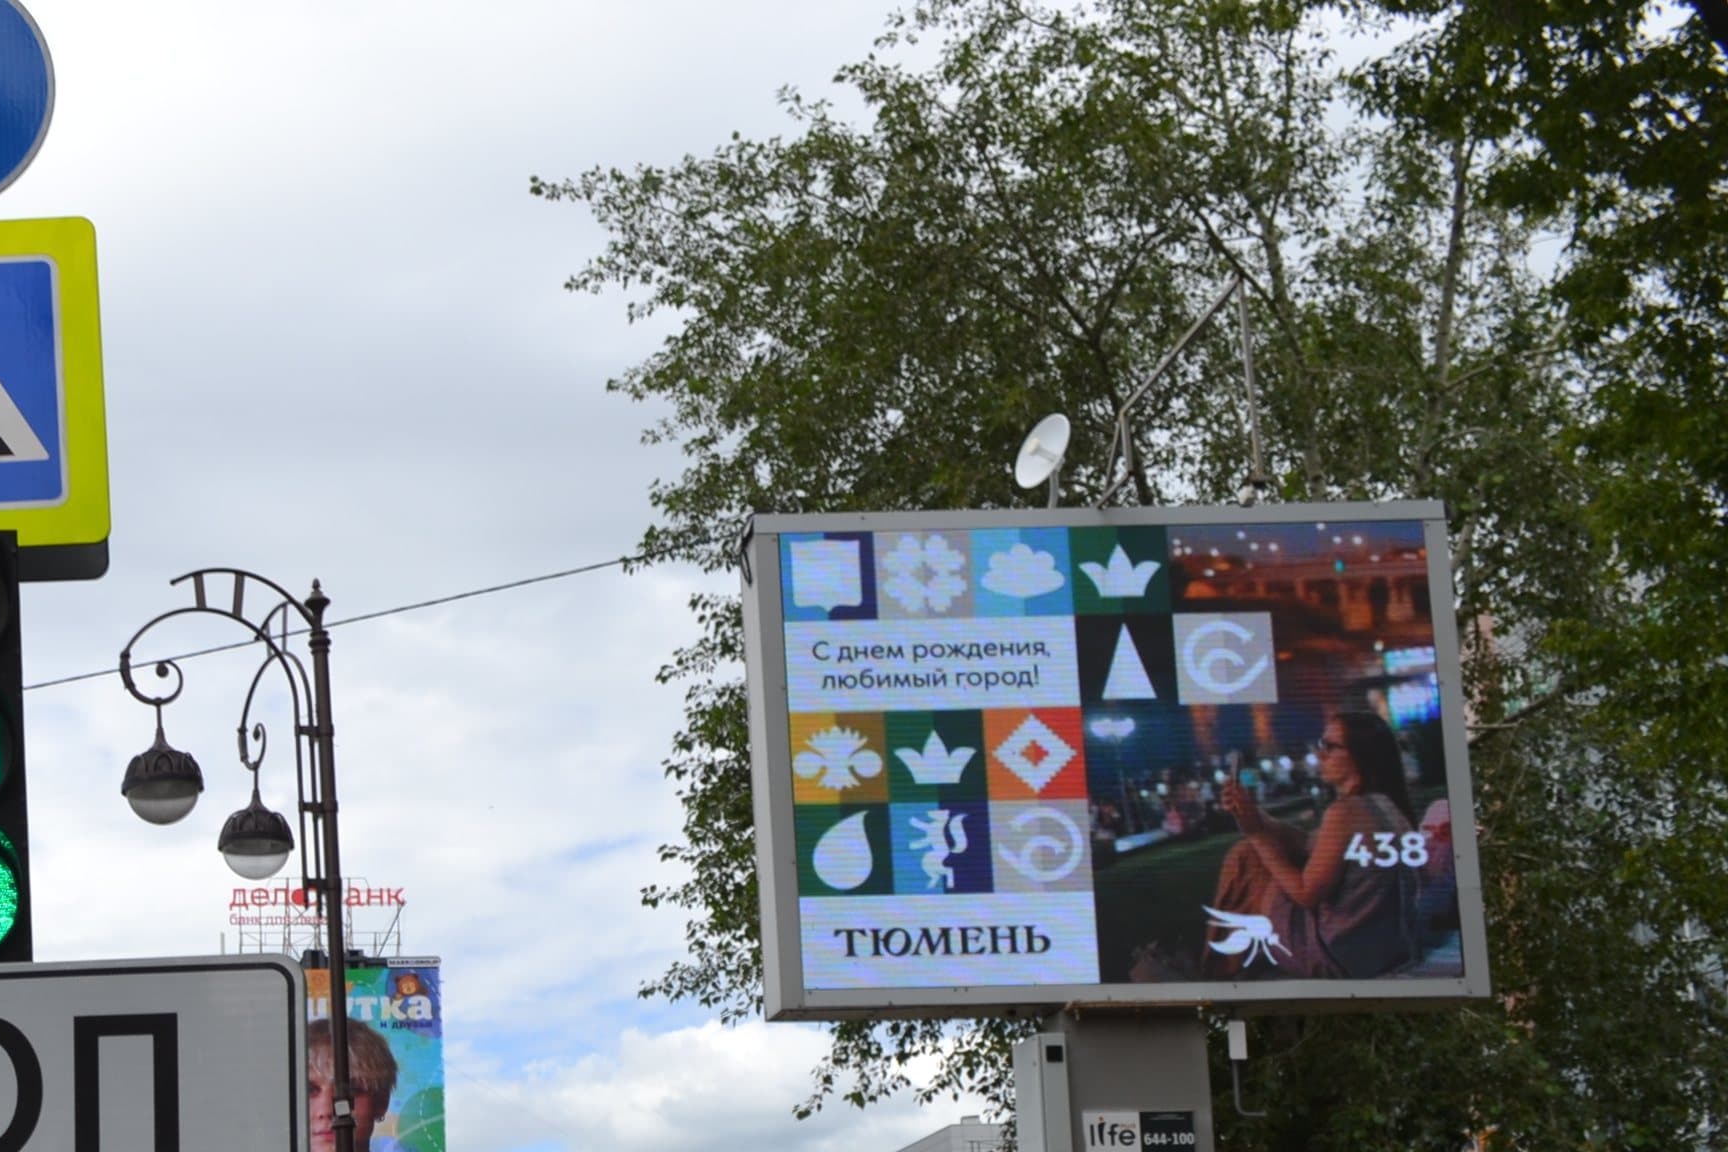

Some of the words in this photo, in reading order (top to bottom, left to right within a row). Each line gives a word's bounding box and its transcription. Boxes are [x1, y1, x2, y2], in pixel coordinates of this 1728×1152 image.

[812, 641, 831, 662] С
[837, 643, 905, 663] днем
[912, 640, 1051, 663] рождения,
[822, 668, 948, 690] любимый
[955, 664, 1040, 690] город!
[1344, 832, 1428, 868] 438
[229, 886, 406, 911] делоанк
[834, 923, 1052, 958] ТЮМЕНЬ
[1089, 1116, 1137, 1147] life
[1143, 1131, 1195, 1146] 644-100
